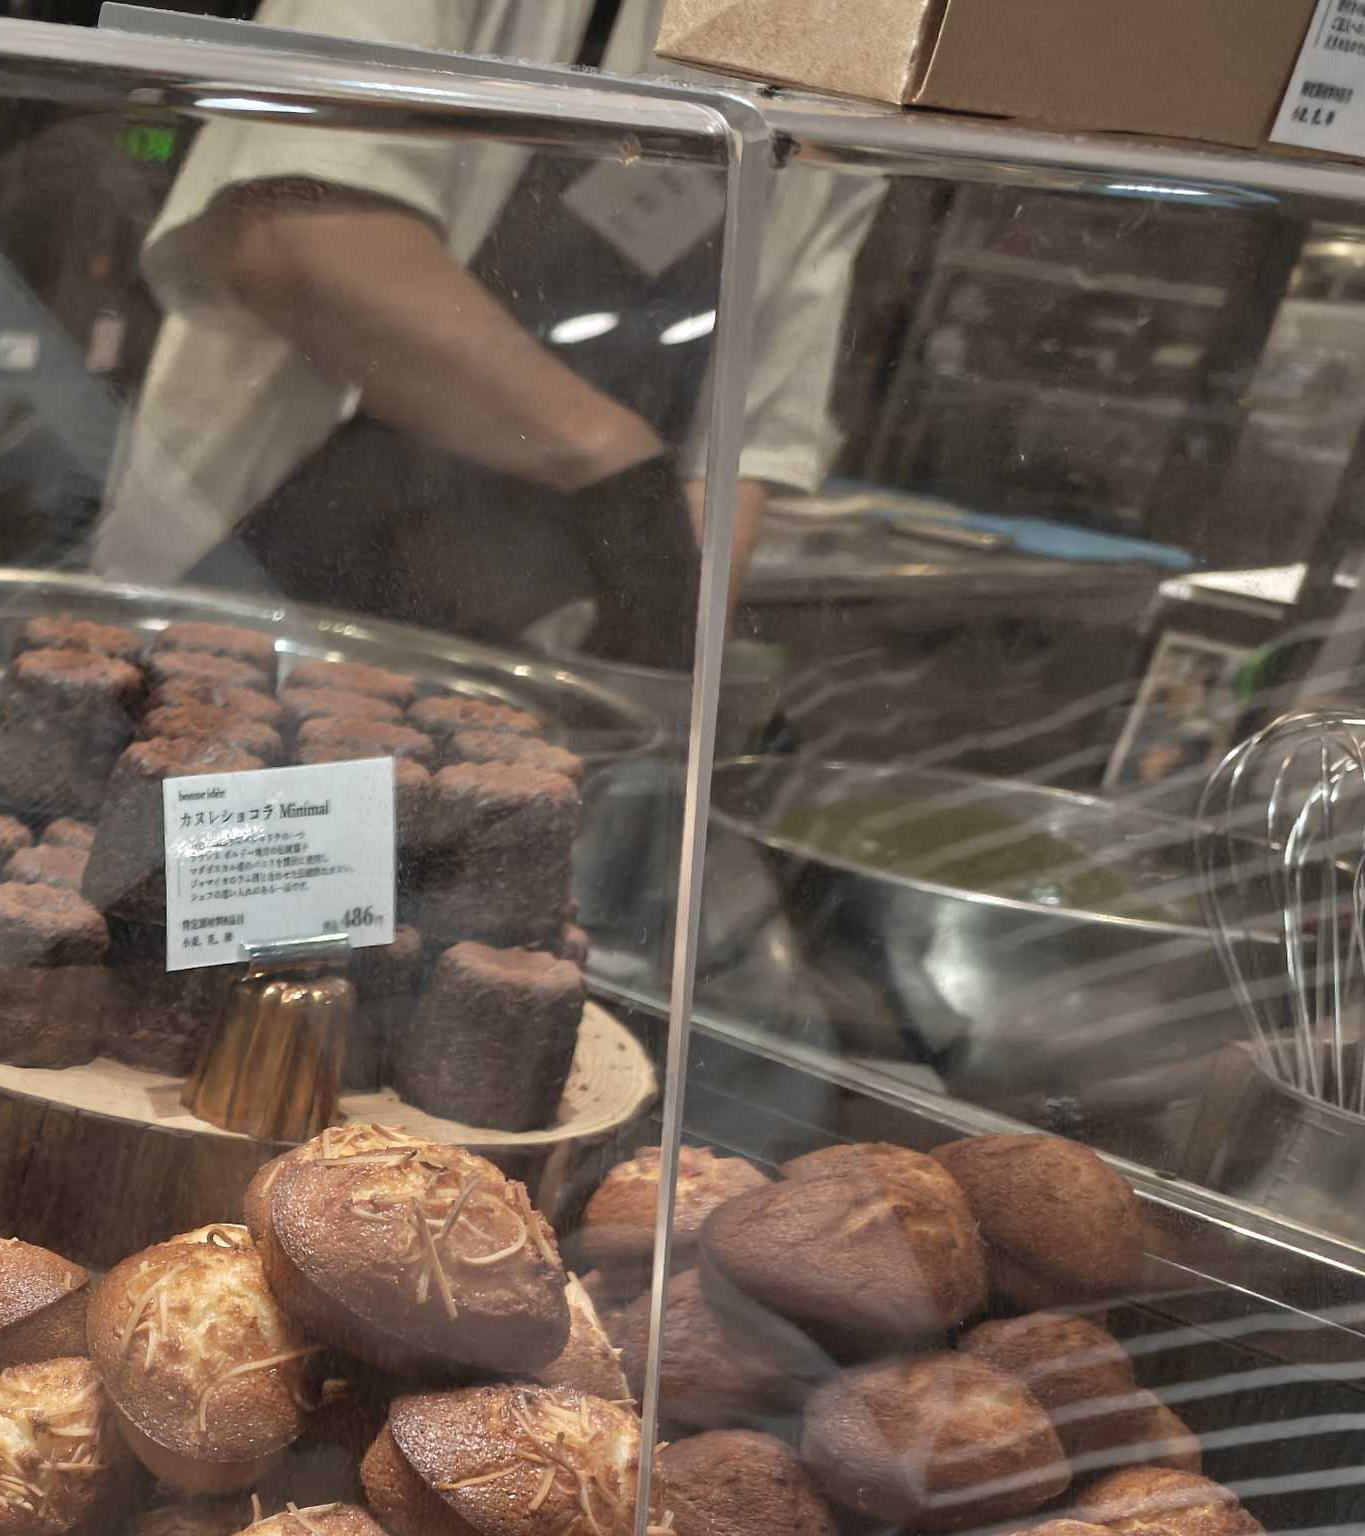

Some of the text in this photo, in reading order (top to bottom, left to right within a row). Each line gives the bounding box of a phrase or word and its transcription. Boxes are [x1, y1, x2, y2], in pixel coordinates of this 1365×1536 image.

[179, 798, 329, 828] カヌレショコラ Minimal
